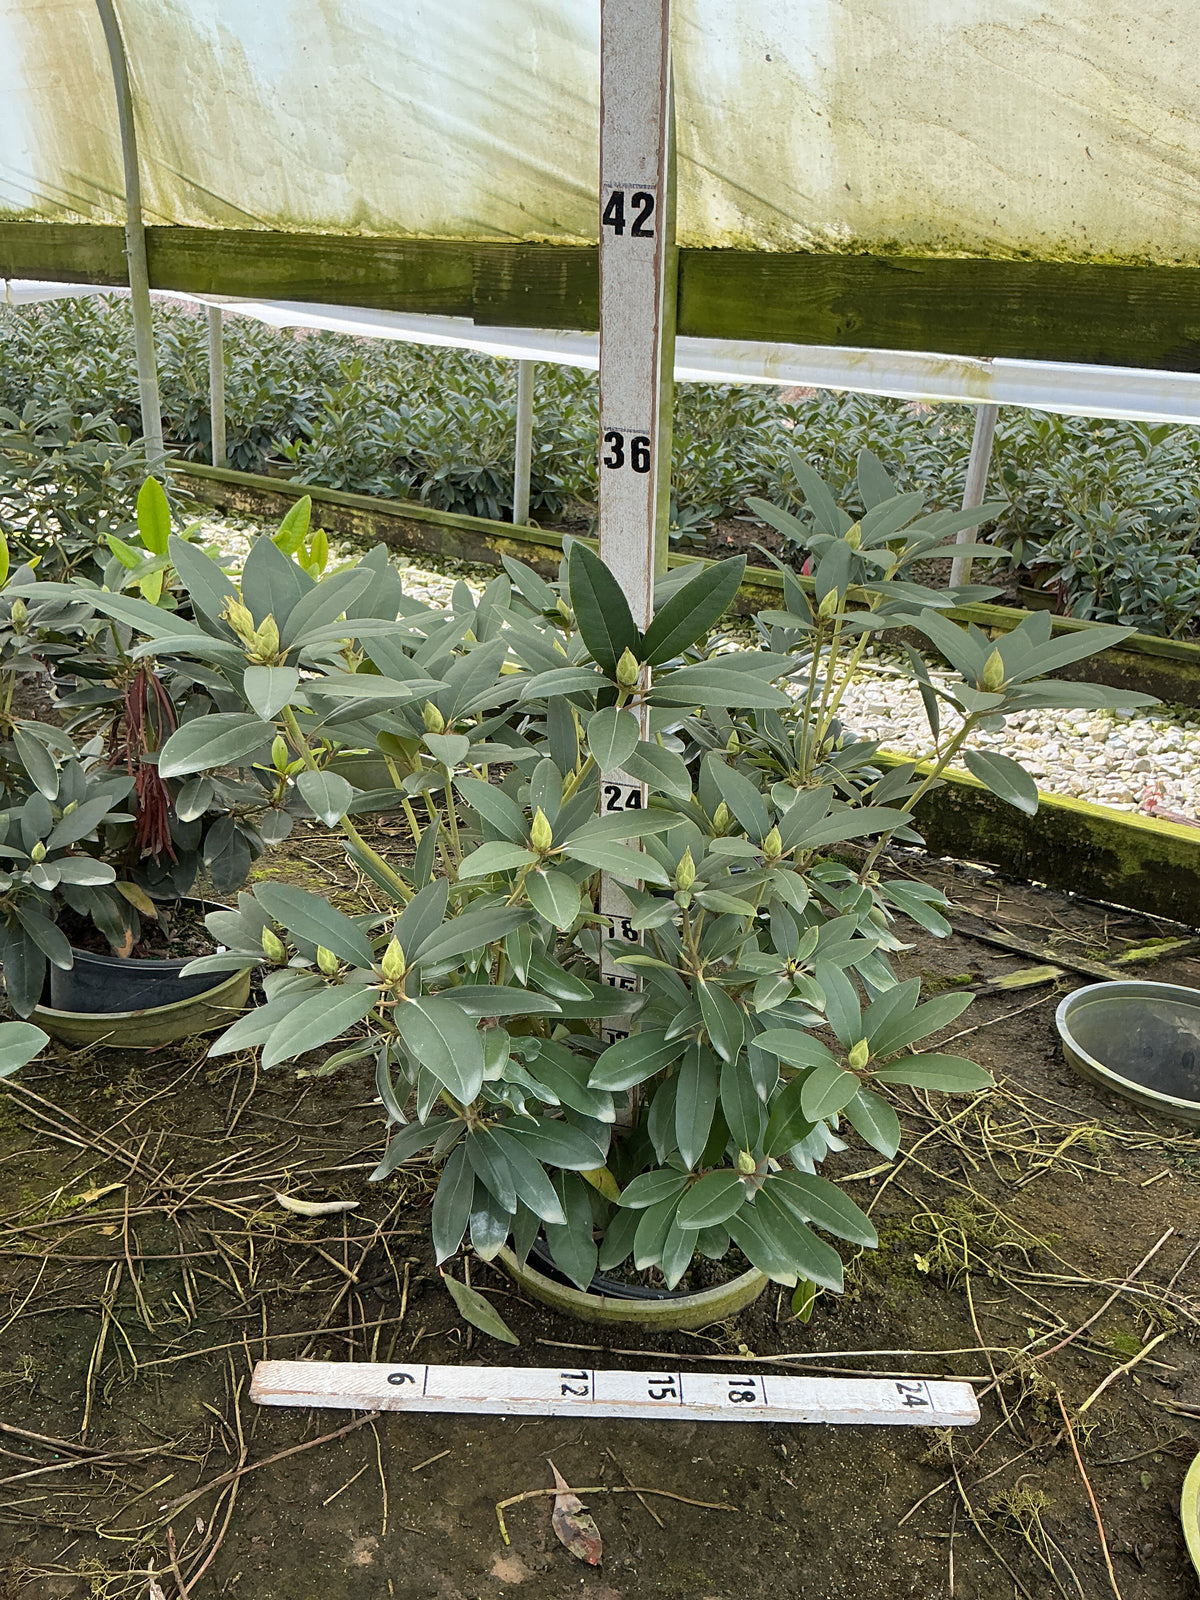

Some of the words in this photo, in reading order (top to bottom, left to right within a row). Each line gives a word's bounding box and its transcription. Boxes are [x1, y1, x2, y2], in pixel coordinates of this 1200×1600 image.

[602, 191, 655, 238] 42
[603, 431, 651, 473] 36
[604, 785, 641, 811] 24
[608, 918, 638, 941] 18
[387, 1372, 415, 1386] 6
[560, 1371, 589, 1397] 12
[647, 1376, 676, 1401] 15
[728, 1377, 756, 1404] 18
[895, 1382, 929, 1409] 24
